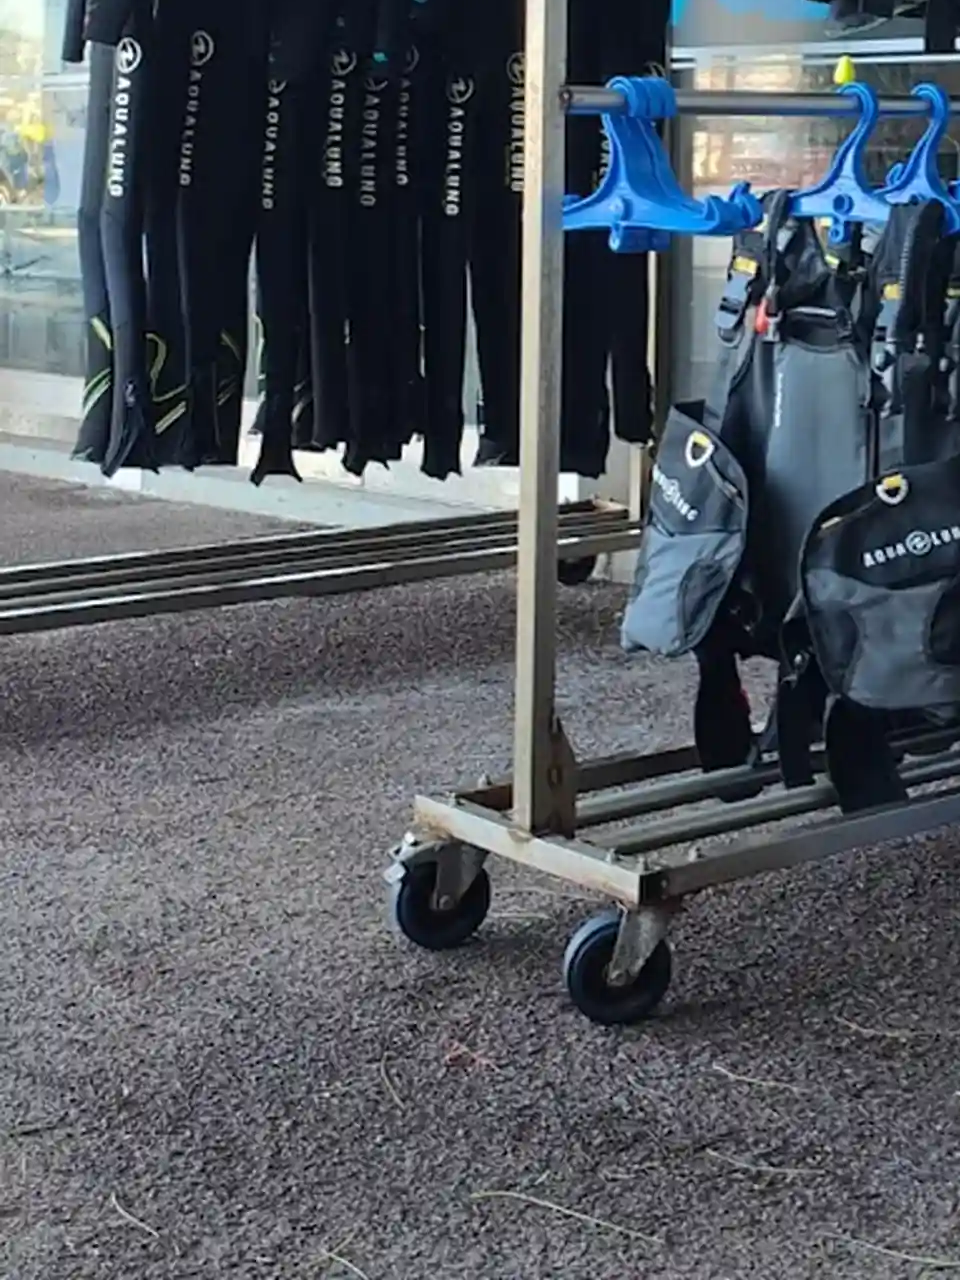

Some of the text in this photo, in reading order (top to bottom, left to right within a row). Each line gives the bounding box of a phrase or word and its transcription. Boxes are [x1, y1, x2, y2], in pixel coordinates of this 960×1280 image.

[107, 76, 132, 198] AQUALUNG
[261, 96, 281, 210] AQUALUNG
[326, 79, 346, 188] AQUALUNG
[360, 94, 381, 207] AQUALUNG
